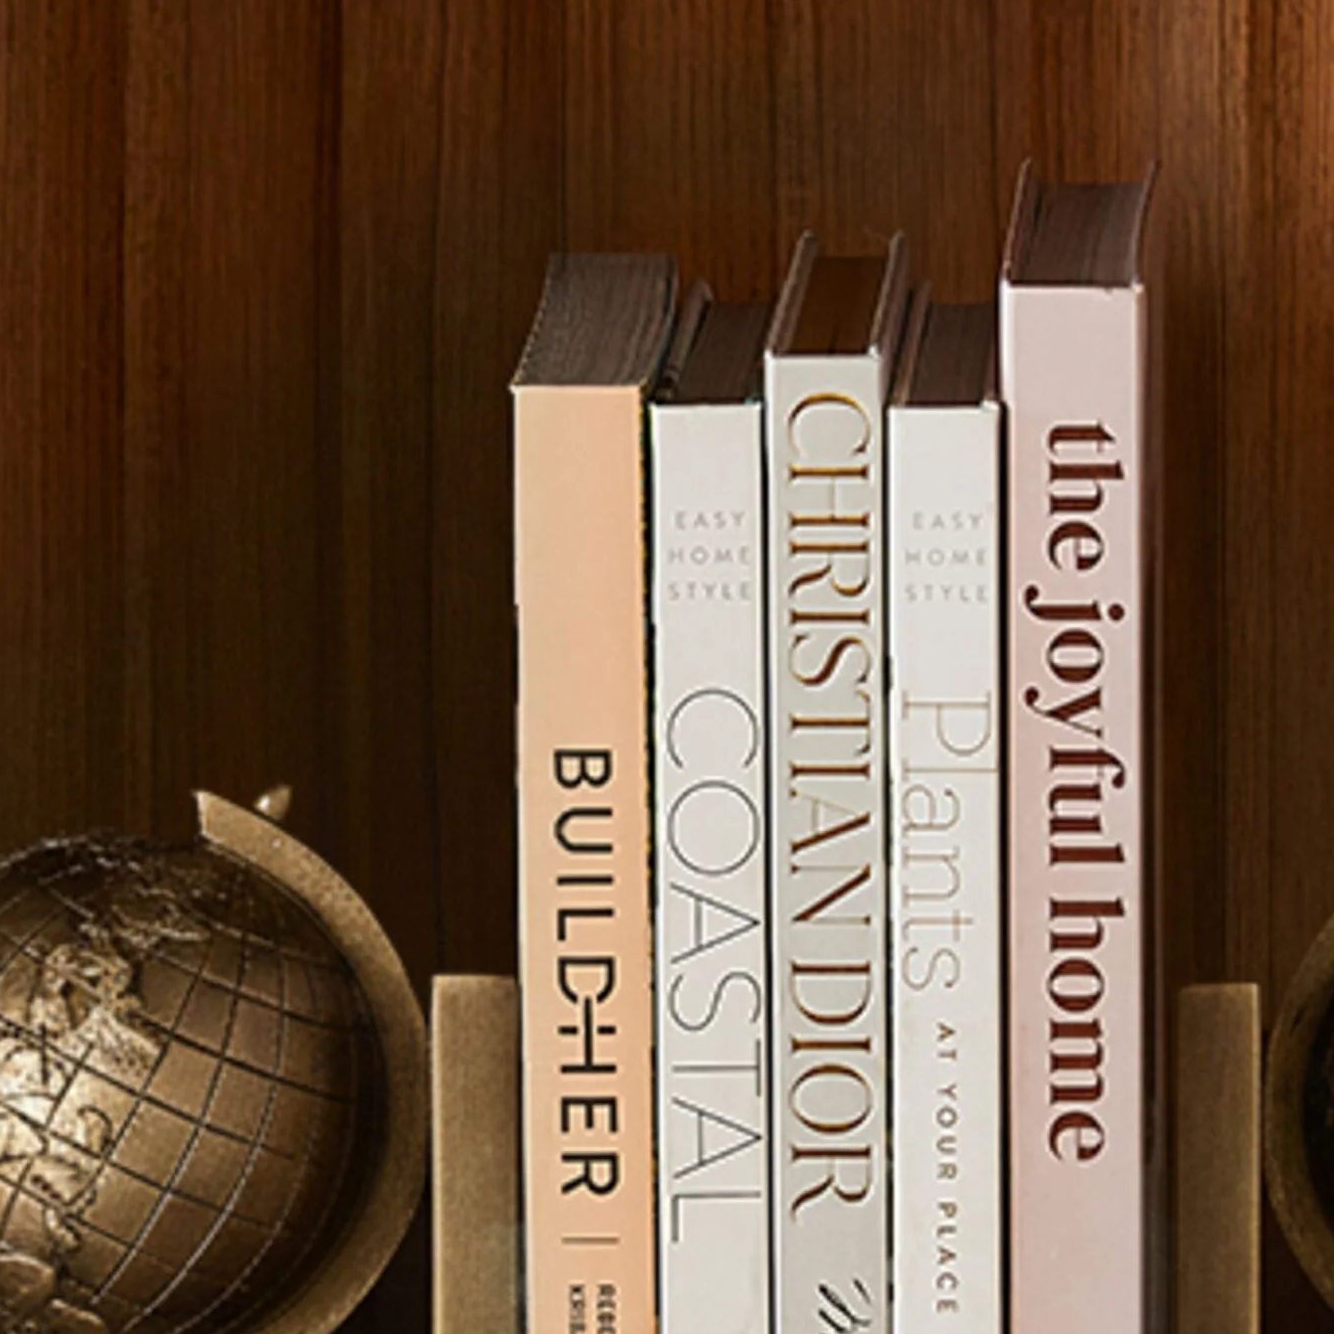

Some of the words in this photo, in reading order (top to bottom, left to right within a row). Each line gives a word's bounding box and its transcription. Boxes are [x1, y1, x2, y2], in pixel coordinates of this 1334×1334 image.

[673, 509, 747, 531] EASY
[911, 509, 984, 531] EASY
[1046, 421, 1126, 571] the
[667, 545, 751, 567] HOME
[667, 580, 752, 602] STYLE
[904, 547, 988, 567] HOME
[904, 583, 989, 604] STYLE
[787, 391, 872, 927] CHRISTIAN
[1022, 584, 1127, 867] joyful
[901, 690, 998, 992] Plants
[666, 688, 763, 1244] COASTAL
[936, 1021, 959, 1061] AT
[1047, 897, 1126, 1163] home
[789, 960, 873, 1224] DIOR
[935, 1082, 960, 1181] YOUR
[935, 1200, 960, 1314] PLACE
